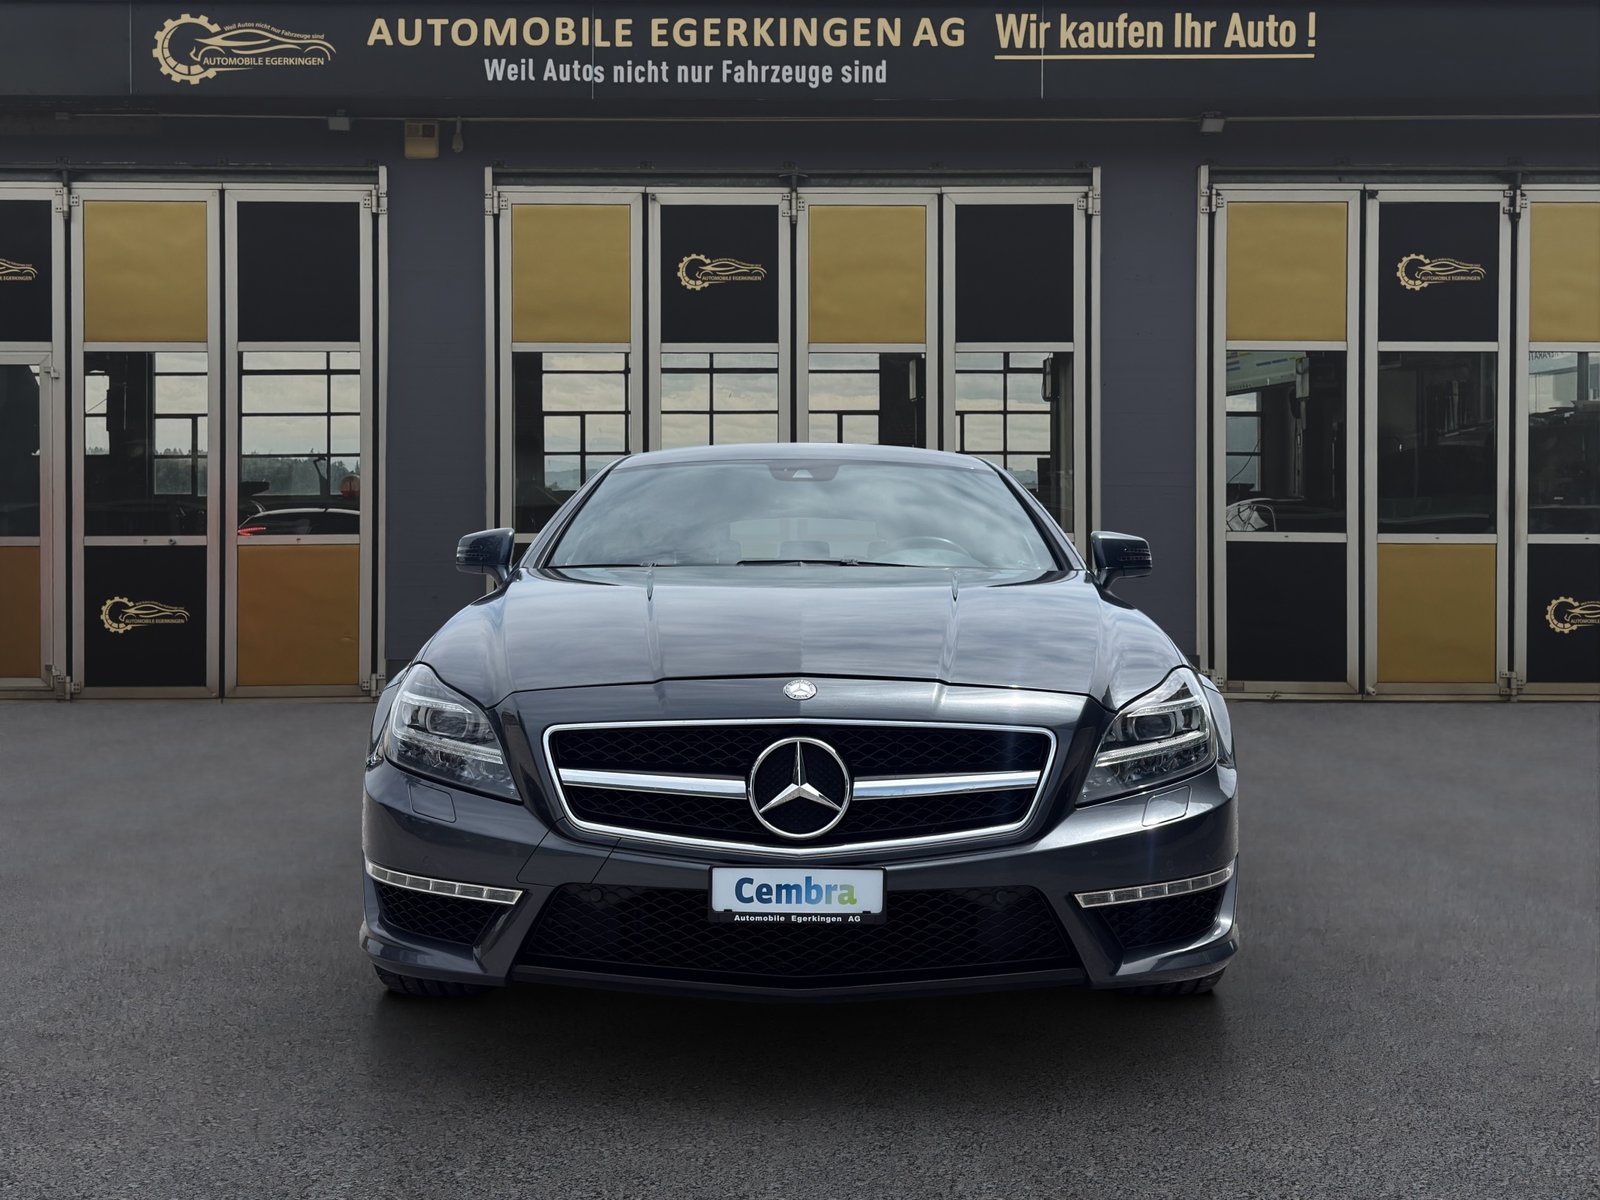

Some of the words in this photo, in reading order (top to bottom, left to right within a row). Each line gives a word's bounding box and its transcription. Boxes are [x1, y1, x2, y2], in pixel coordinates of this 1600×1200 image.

[224, 23, 237, 32] Weil
[255, 22, 271, 31] nicht
[270, 26, 282, 34] nur
[280, 29, 311, 40] Fahrzeuge
[366, 17, 634, 48] AUTOMOBILE
[650, 17, 902, 48] EGERKINGEN
[912, 17, 966, 48] AG
[995, 13, 1051, 49] Wir
[1059, 12, 1164, 49] kaufen
[1174, 12, 1217, 48] Ihr
[1223, 12, 1297, 48] Auto
[203, 57, 264, 66] AUTOMOBILE
[265, 57, 325, 66] EGERKINGEN
[484, 58, 536, 82] Weil
[543, 58, 605, 84] Autos
[613, 60, 669, 84] nicht
[677, 64, 714, 84] nur
[721, 60, 833, 89] Fahrzeuge
[841, 60, 888, 84] sind
[735, 876, 858, 906] Cembra
[734, 915, 786, 923] Automobile
[791, 915, 843, 924] Egerkingen
[848, 915, 862, 923] AG
